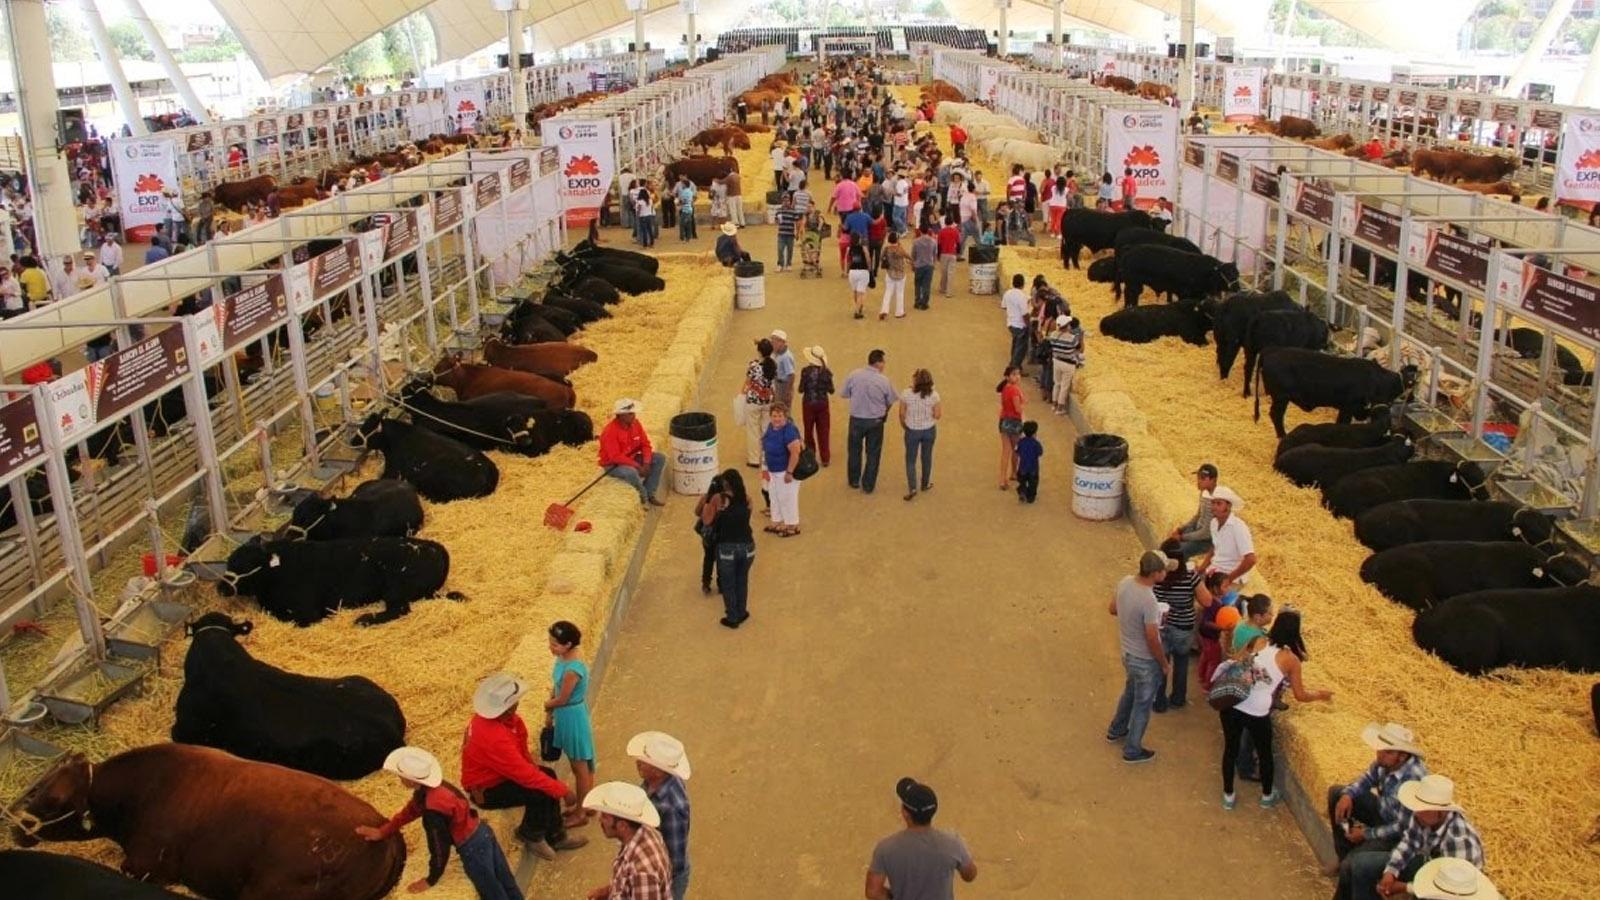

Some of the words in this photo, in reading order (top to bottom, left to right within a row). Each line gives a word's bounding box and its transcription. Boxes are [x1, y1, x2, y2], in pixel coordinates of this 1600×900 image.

[1132, 168, 1159, 178] XPO
[568, 178, 600, 188] EXPO
[1115, 176, 1166, 187] Gadera
[138, 195, 159, 206] EXP
[1075, 477, 1114, 490] Comex
